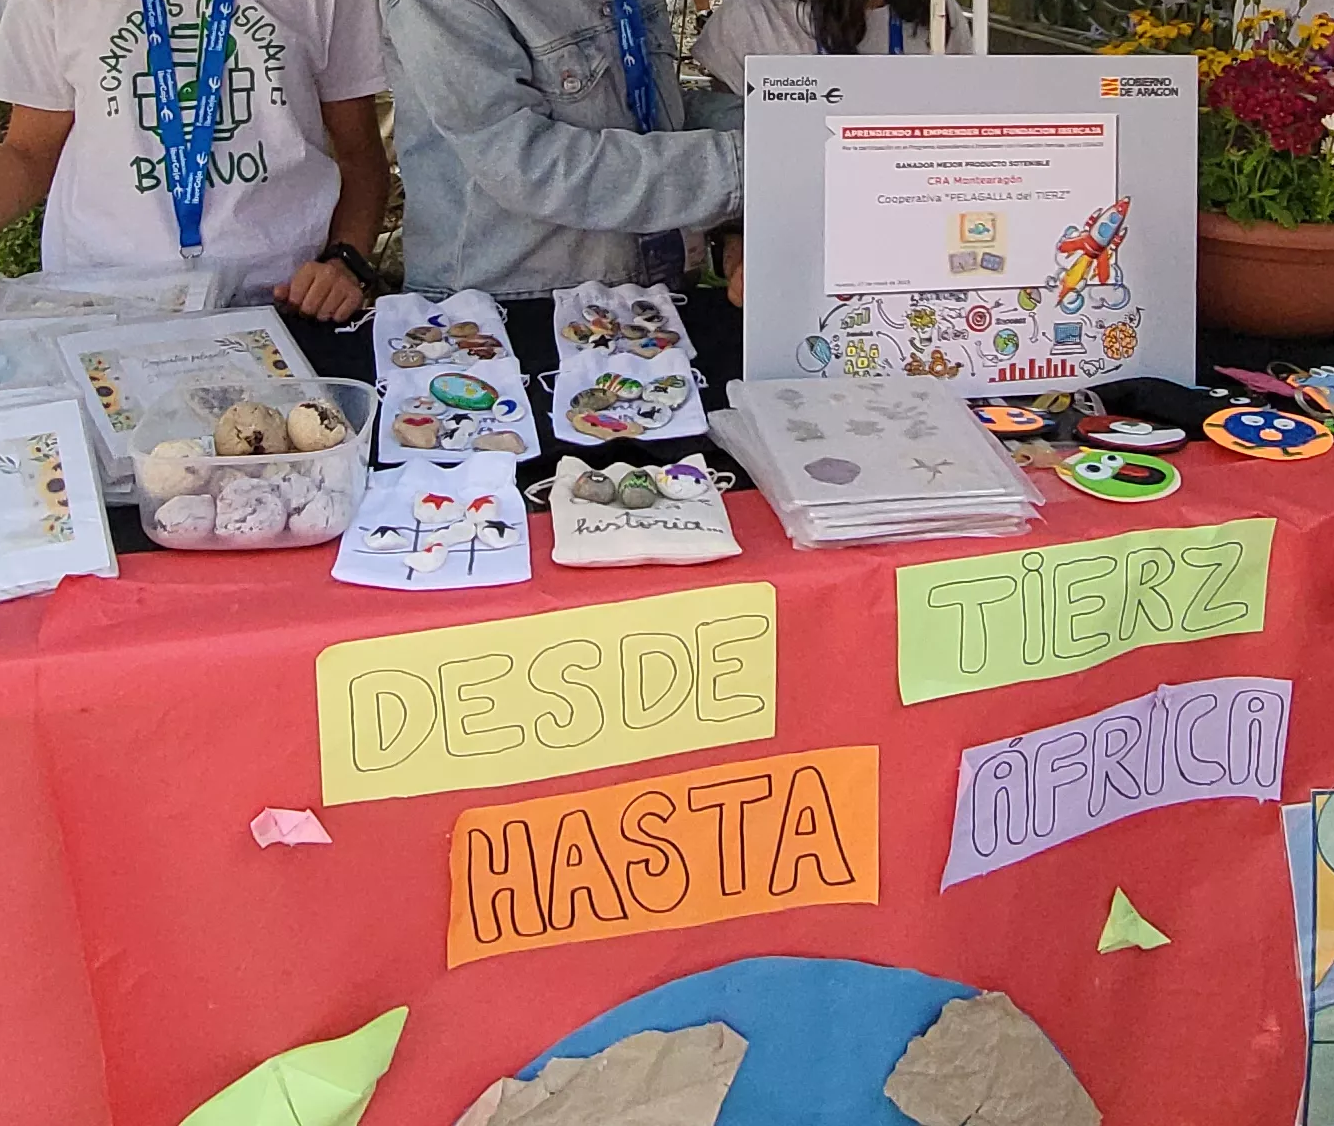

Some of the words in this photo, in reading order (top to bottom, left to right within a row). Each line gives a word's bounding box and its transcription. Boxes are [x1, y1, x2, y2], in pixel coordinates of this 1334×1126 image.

[762, 77, 818, 87] Fundación
[1120, 77, 1172, 87] GOBIERNO
[762, 89, 818, 104] Ibercaja
[1120, 87, 1134, 97] DE
[927, 176, 950, 186] CRA
[877, 193, 942, 205] Cooperativa
[1016, 191, 1033, 201] del
[350, 614, 770, 774] DESDE
[466, 765, 856, 944] HASTA
